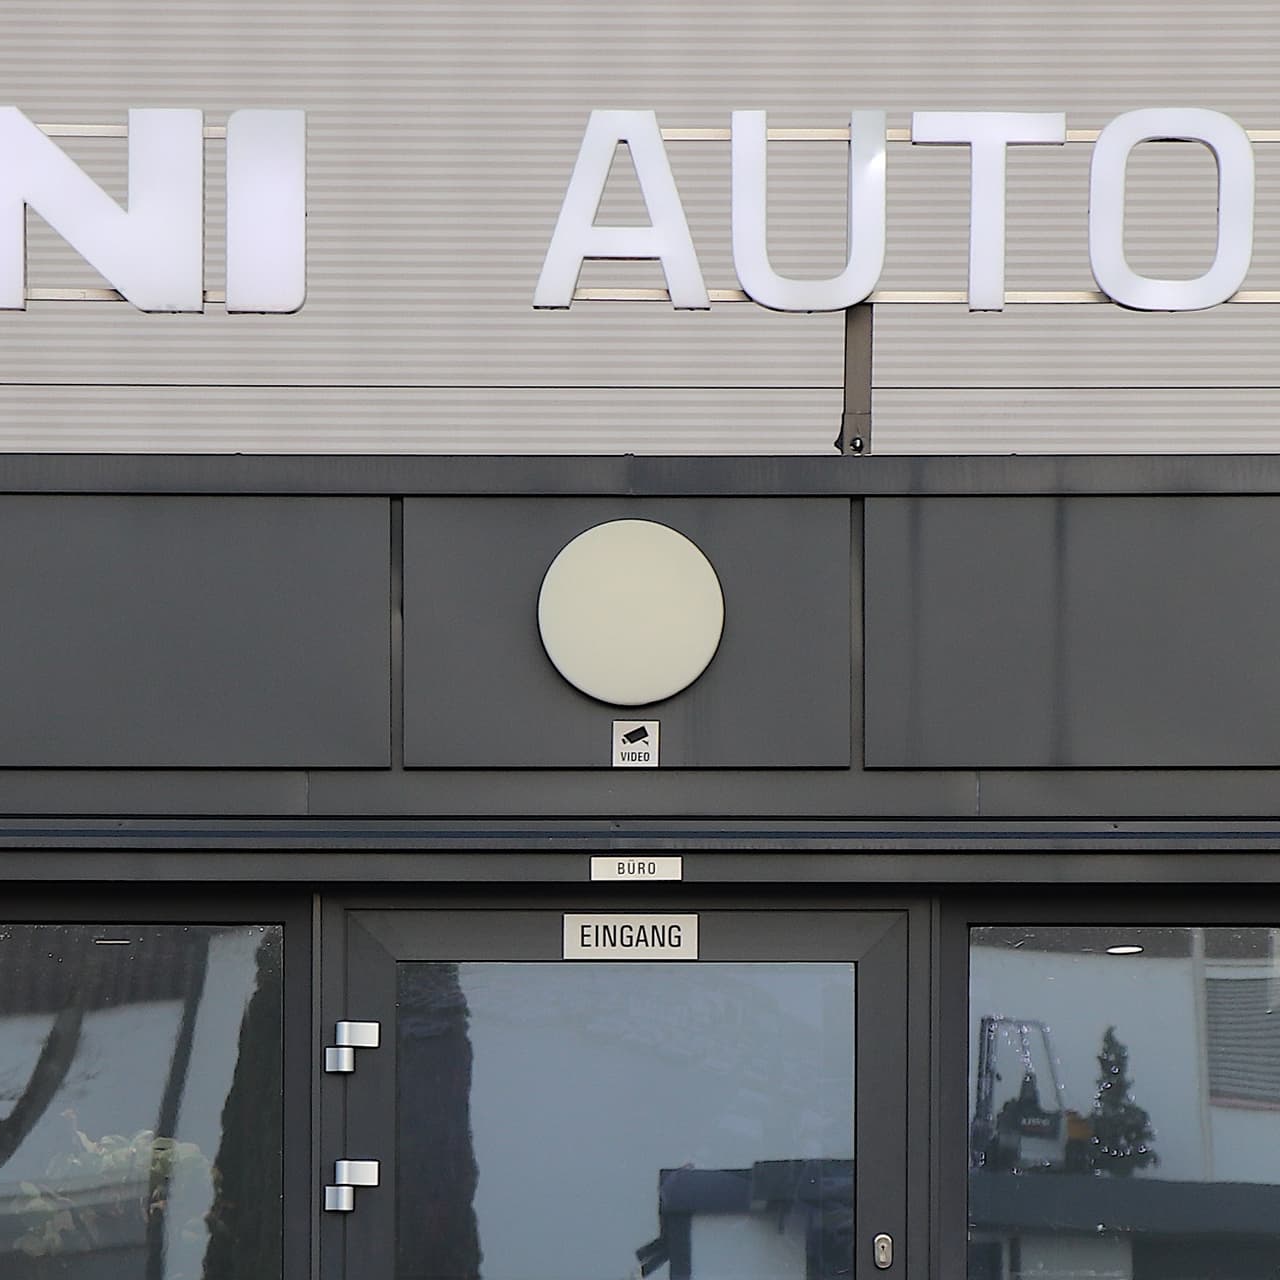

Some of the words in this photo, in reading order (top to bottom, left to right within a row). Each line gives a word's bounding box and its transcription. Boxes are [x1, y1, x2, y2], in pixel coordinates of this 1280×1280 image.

[533, 105, 1257, 314] AUTO
[620, 751, 650, 762] VIDEO
[617, 859, 656, 875] BÜRO
[580, 924, 682, 948] EINGANG
